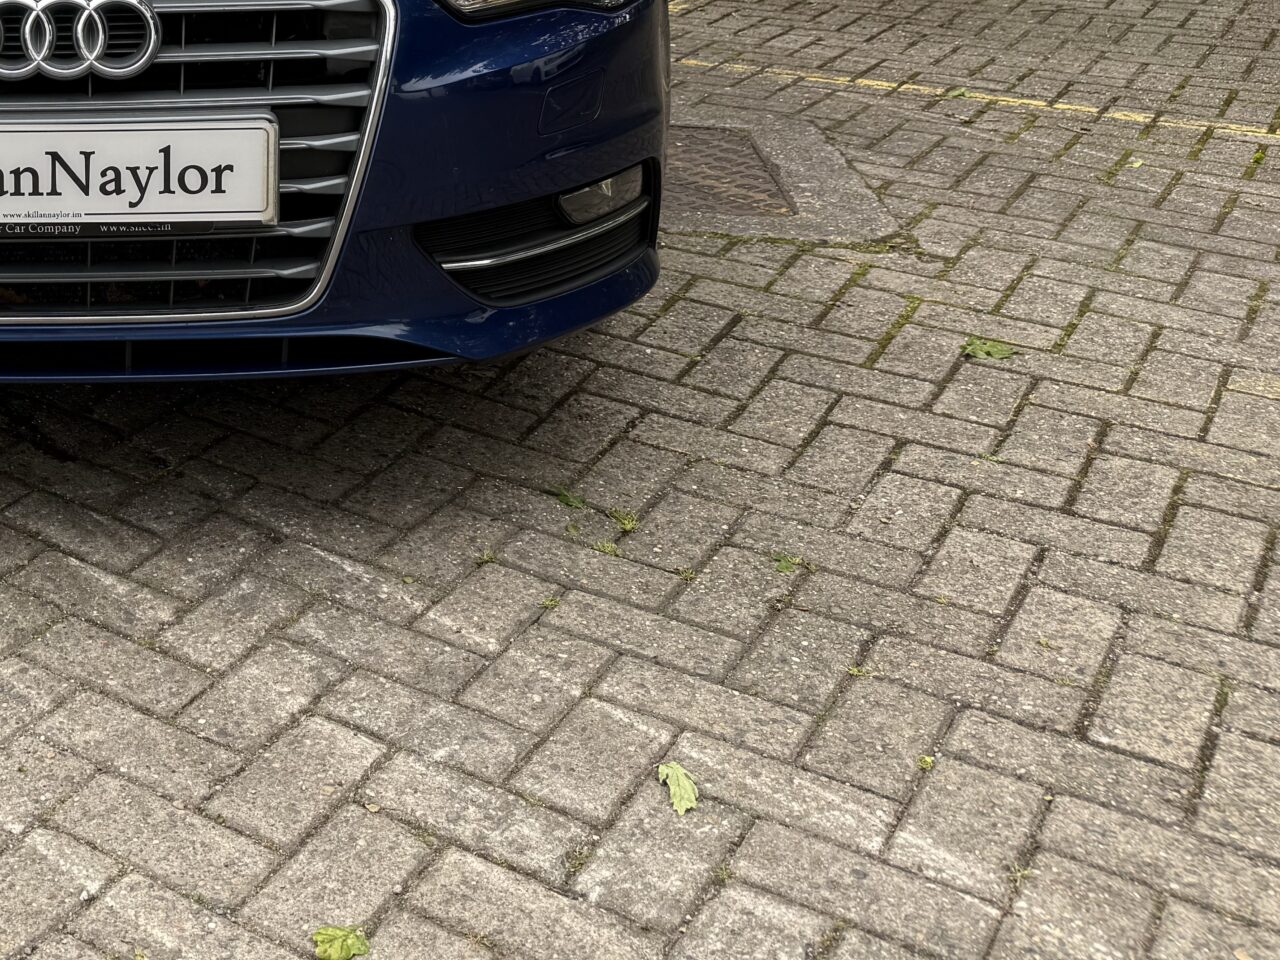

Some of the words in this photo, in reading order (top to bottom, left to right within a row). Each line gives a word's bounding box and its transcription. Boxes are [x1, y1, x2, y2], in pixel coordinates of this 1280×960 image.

[2, 210, 83, 220] www.skillannaylor.im
[5, 223, 26, 233] Car
[28, 223, 81, 235] Company
